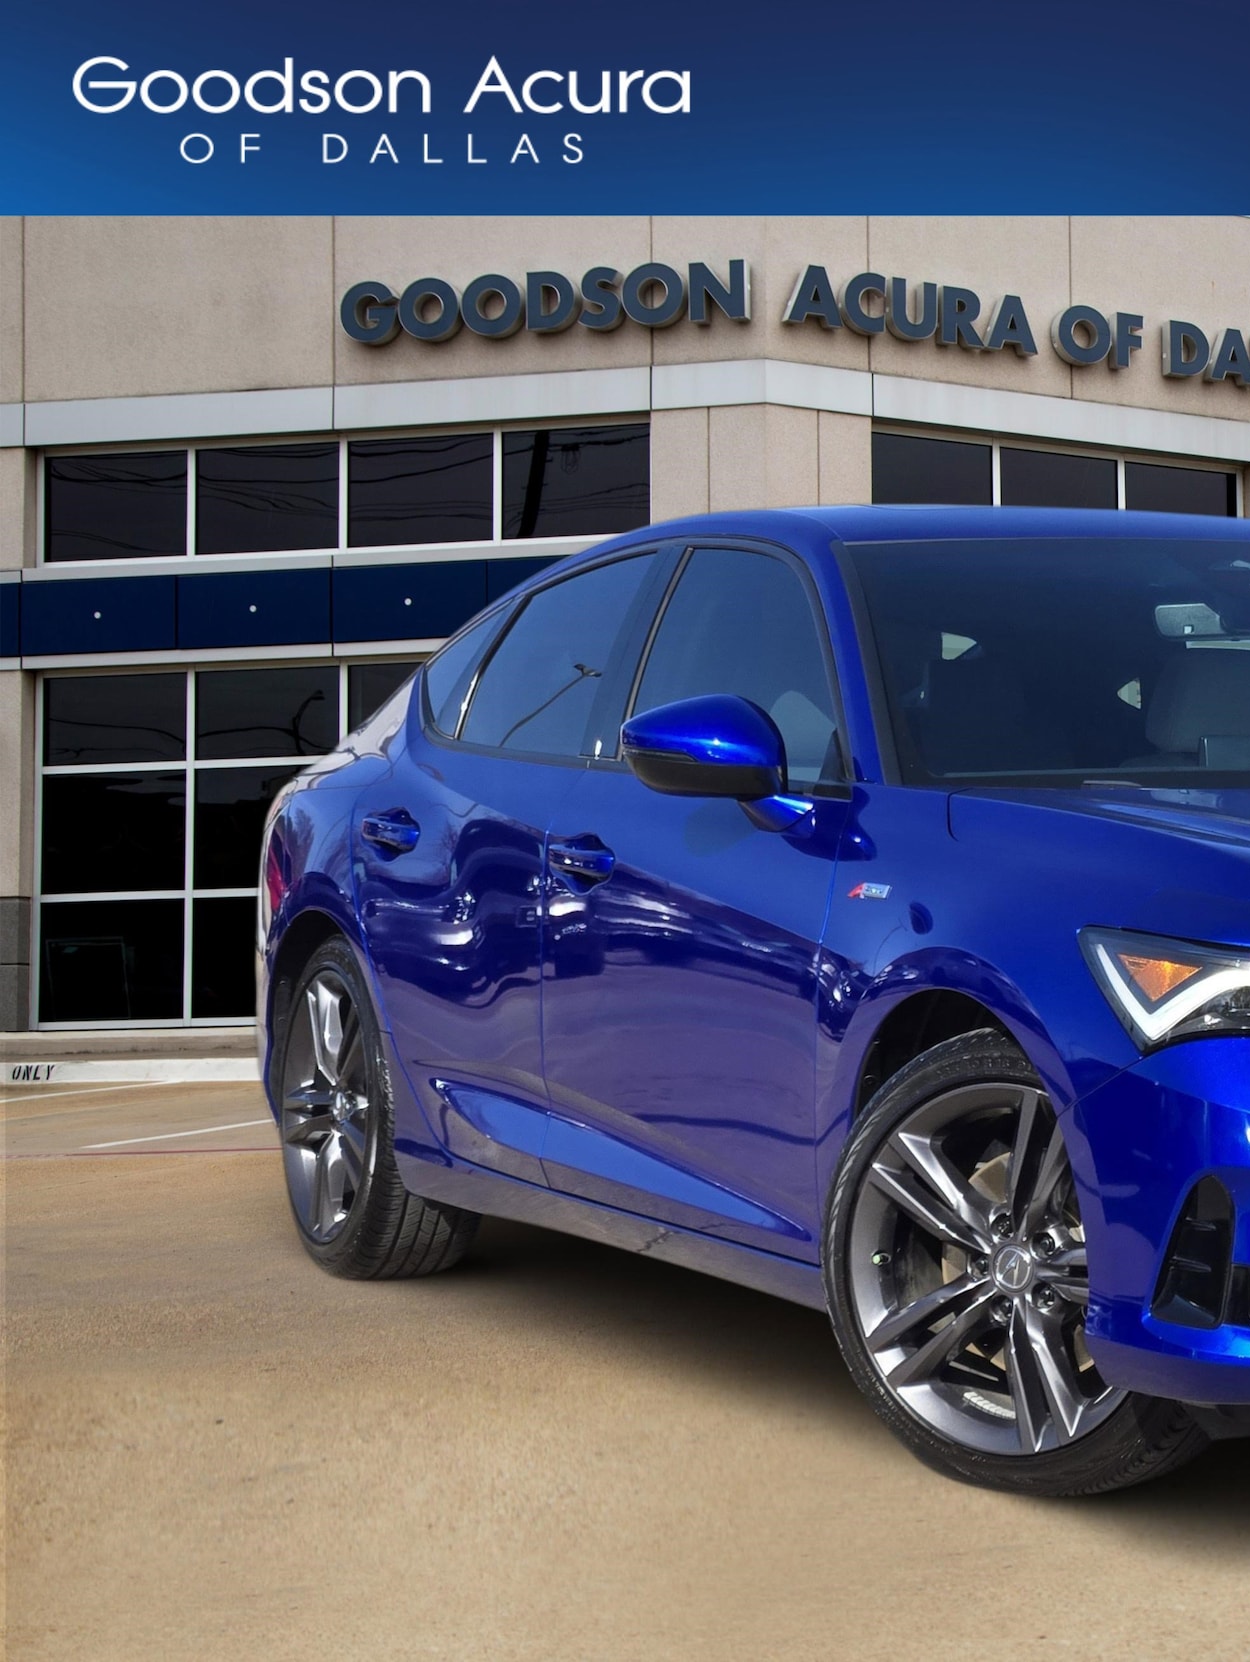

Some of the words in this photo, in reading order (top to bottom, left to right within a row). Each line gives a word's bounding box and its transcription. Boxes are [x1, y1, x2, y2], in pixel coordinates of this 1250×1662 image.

[340, 259, 752, 346] GOODSON
[782, 265, 1038, 357] ACURA
[1051, 304, 1144, 370] OF
[12, 1065, 55, 1081] ONLY
